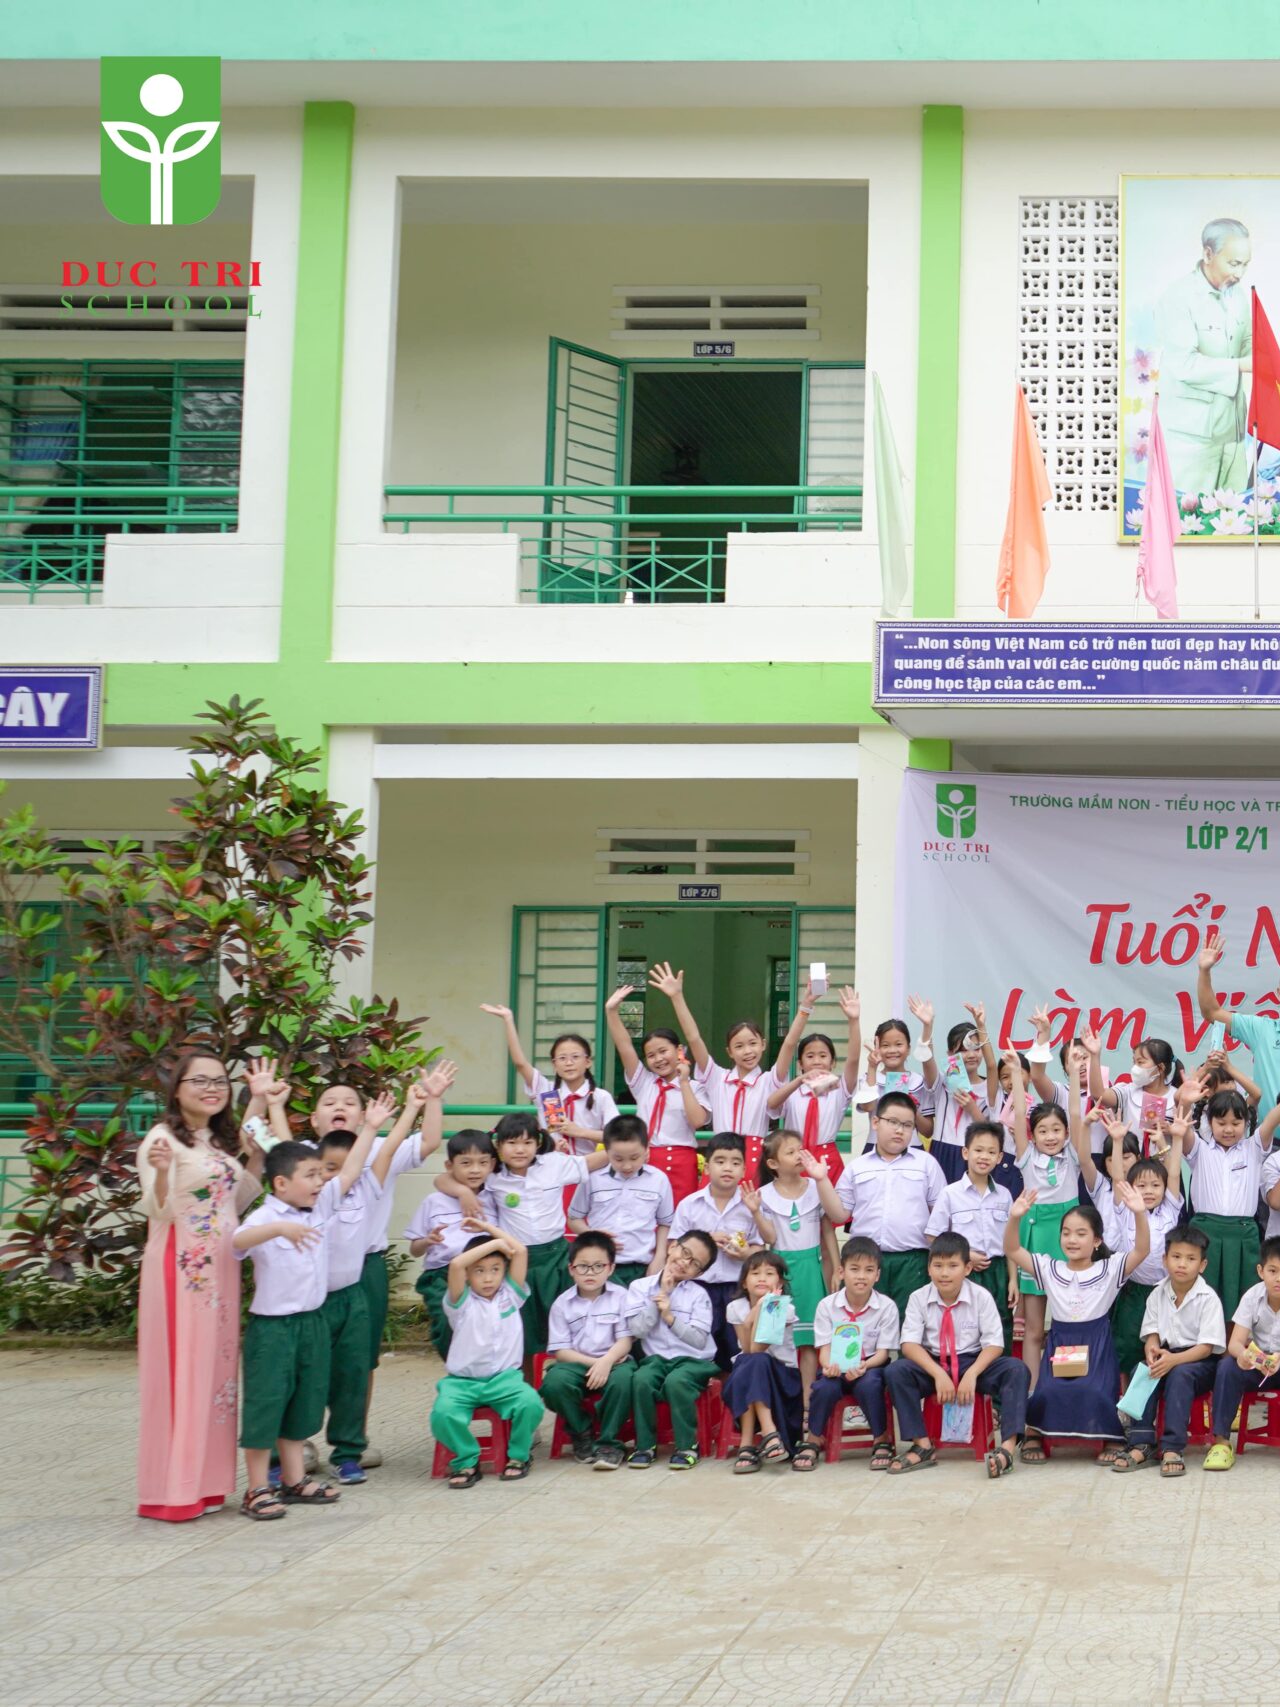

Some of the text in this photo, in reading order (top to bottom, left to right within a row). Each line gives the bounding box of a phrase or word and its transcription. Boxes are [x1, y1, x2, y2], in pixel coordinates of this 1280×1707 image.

[714, 345, 732, 354] 5/6
[953, 636, 991, 652] sông
[995, 636, 1025, 653] Việt
[1029, 637, 1065, 650] Nam
[1069, 636, 1089, 650] có
[1092, 635, 1115, 651] trở
[1118, 637, 1147, 651] nên
[1151, 637, 1181, 651] tươi
[1185, 637, 1215, 654] đẹp
[1219, 637, 1247, 653] hay
[894, 658, 943, 671] quang
[945, 654, 965, 670] để
[967, 657, 1005, 670] sánh
[1007, 657, 1031, 670] vai
[1033, 656, 1057, 670] với
[1060, 657, 1089, 671] các
[1092, 656, 1140, 672] cường
[1143, 655, 1181, 672] quốc
[1184, 656, 1218, 671] năm
[1221, 657, 1260, 671] châu
[894, 676, 933, 691] công
[935, 676, 965, 693] học
[967, 676, 992, 693] tập
[994, 674, 1024, 690] của
[1026, 676, 1055, 690] các
[0, 686, 70, 727] ÂY
[1009, 794, 1073, 809] TRƯỜNG
[1118, 798, 1151, 811] NON
[1165, 793, 1199, 811] TIỂU
[1203, 800, 1236, 814] HỌC
[1241, 798, 1261, 812] VÀ
[1186, 820, 1268, 853] LỚP 2/1
[923, 841, 990, 853] DUC TRI
[922, 852, 990, 863] SCHOOL
[700, 888, 718, 897] 2/6
[1086, 892, 1227, 967] Tuổi
[998, 987, 1150, 1051] Làm
